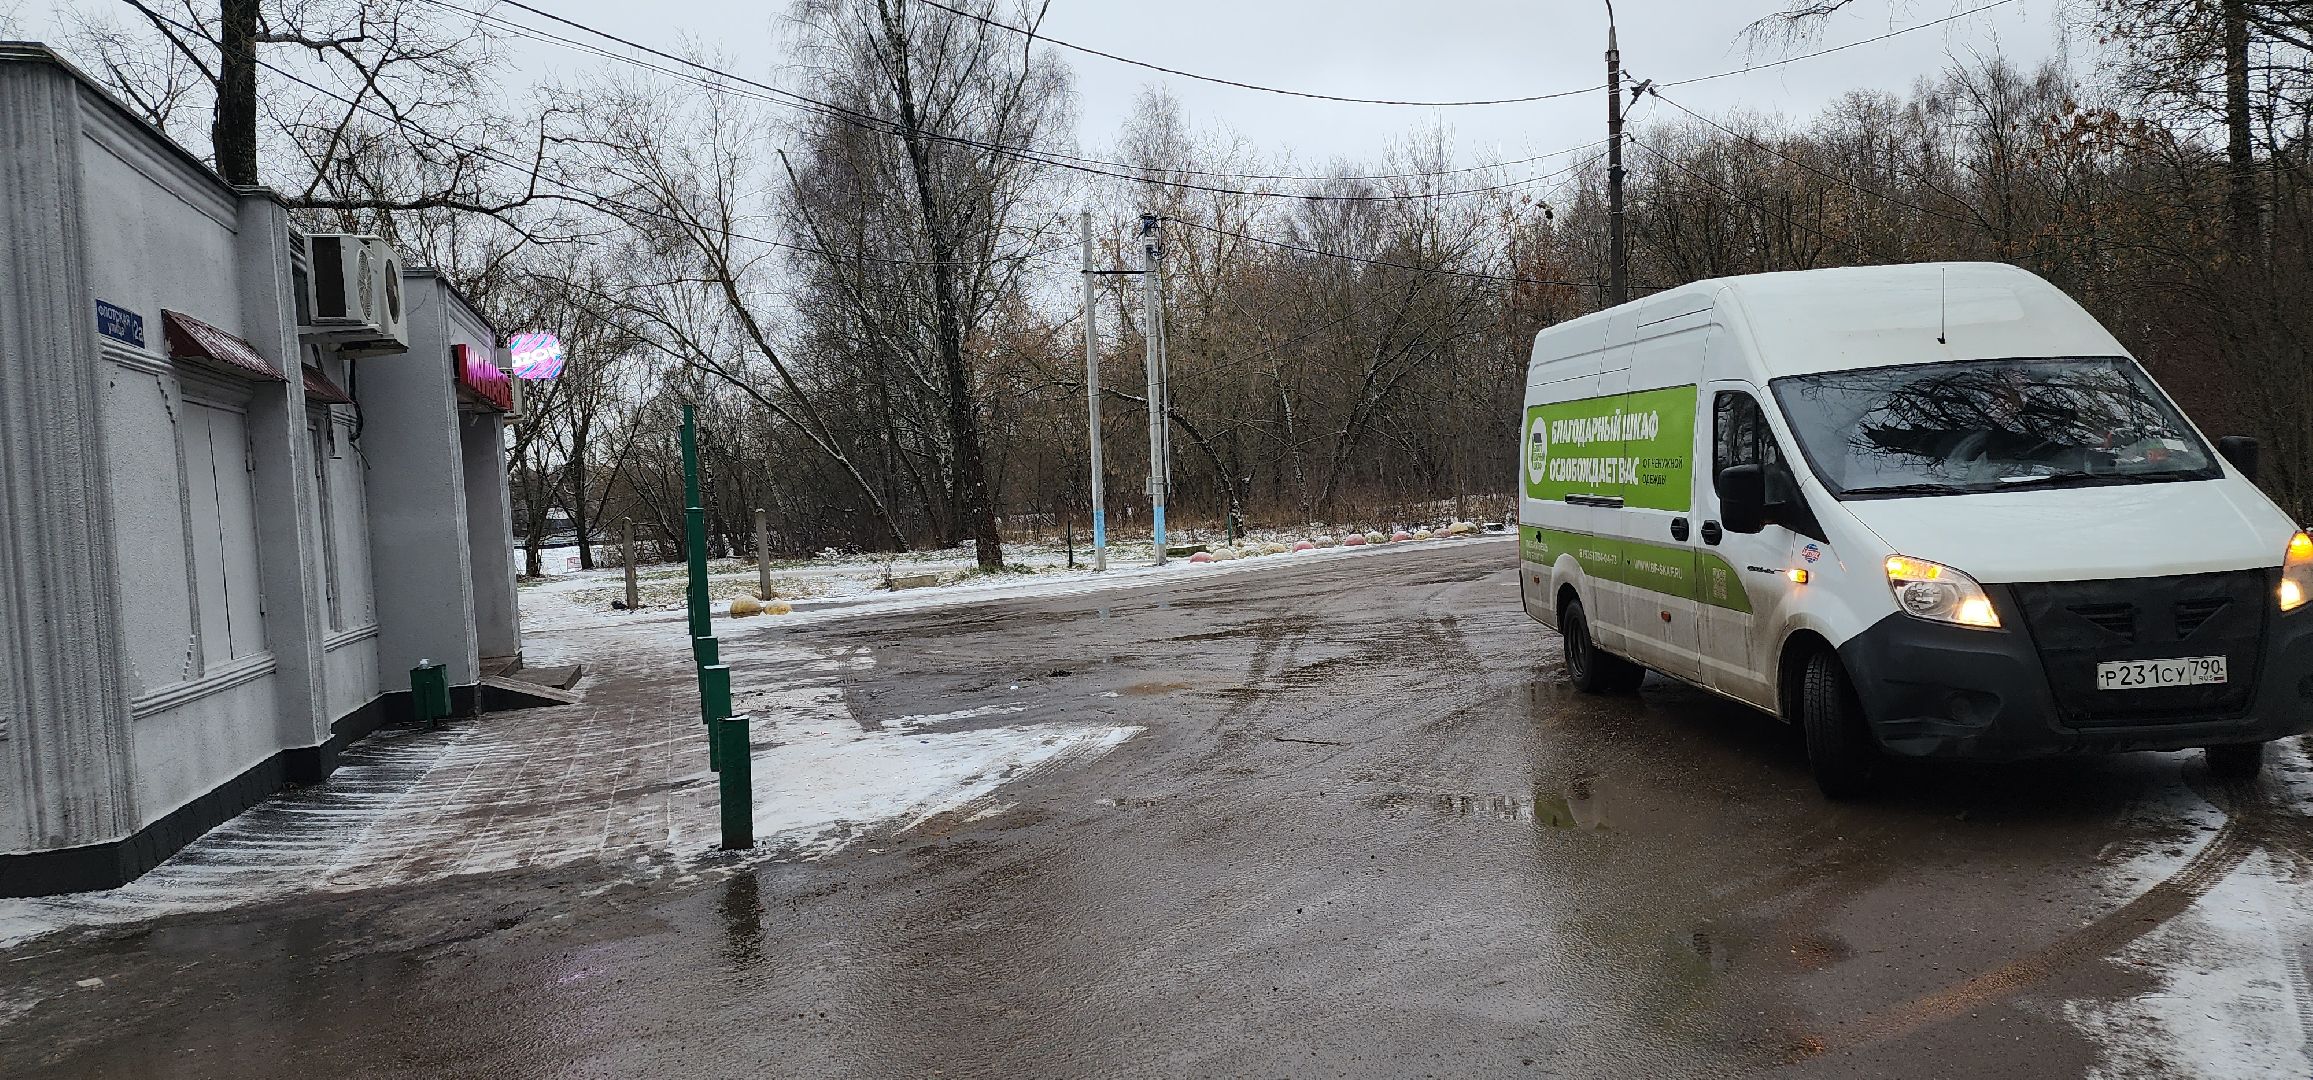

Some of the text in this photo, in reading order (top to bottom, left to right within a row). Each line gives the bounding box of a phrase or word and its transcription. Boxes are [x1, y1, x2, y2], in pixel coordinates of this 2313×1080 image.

[1551, 408, 1659, 447] БЛАГОДАРНЫЙ ШКАФ
[1549, 457, 1617, 487] ОСВОБОЖДАЕТ
[1618, 456, 1640, 485] ВАС
[2189, 660, 2221, 676] 790
